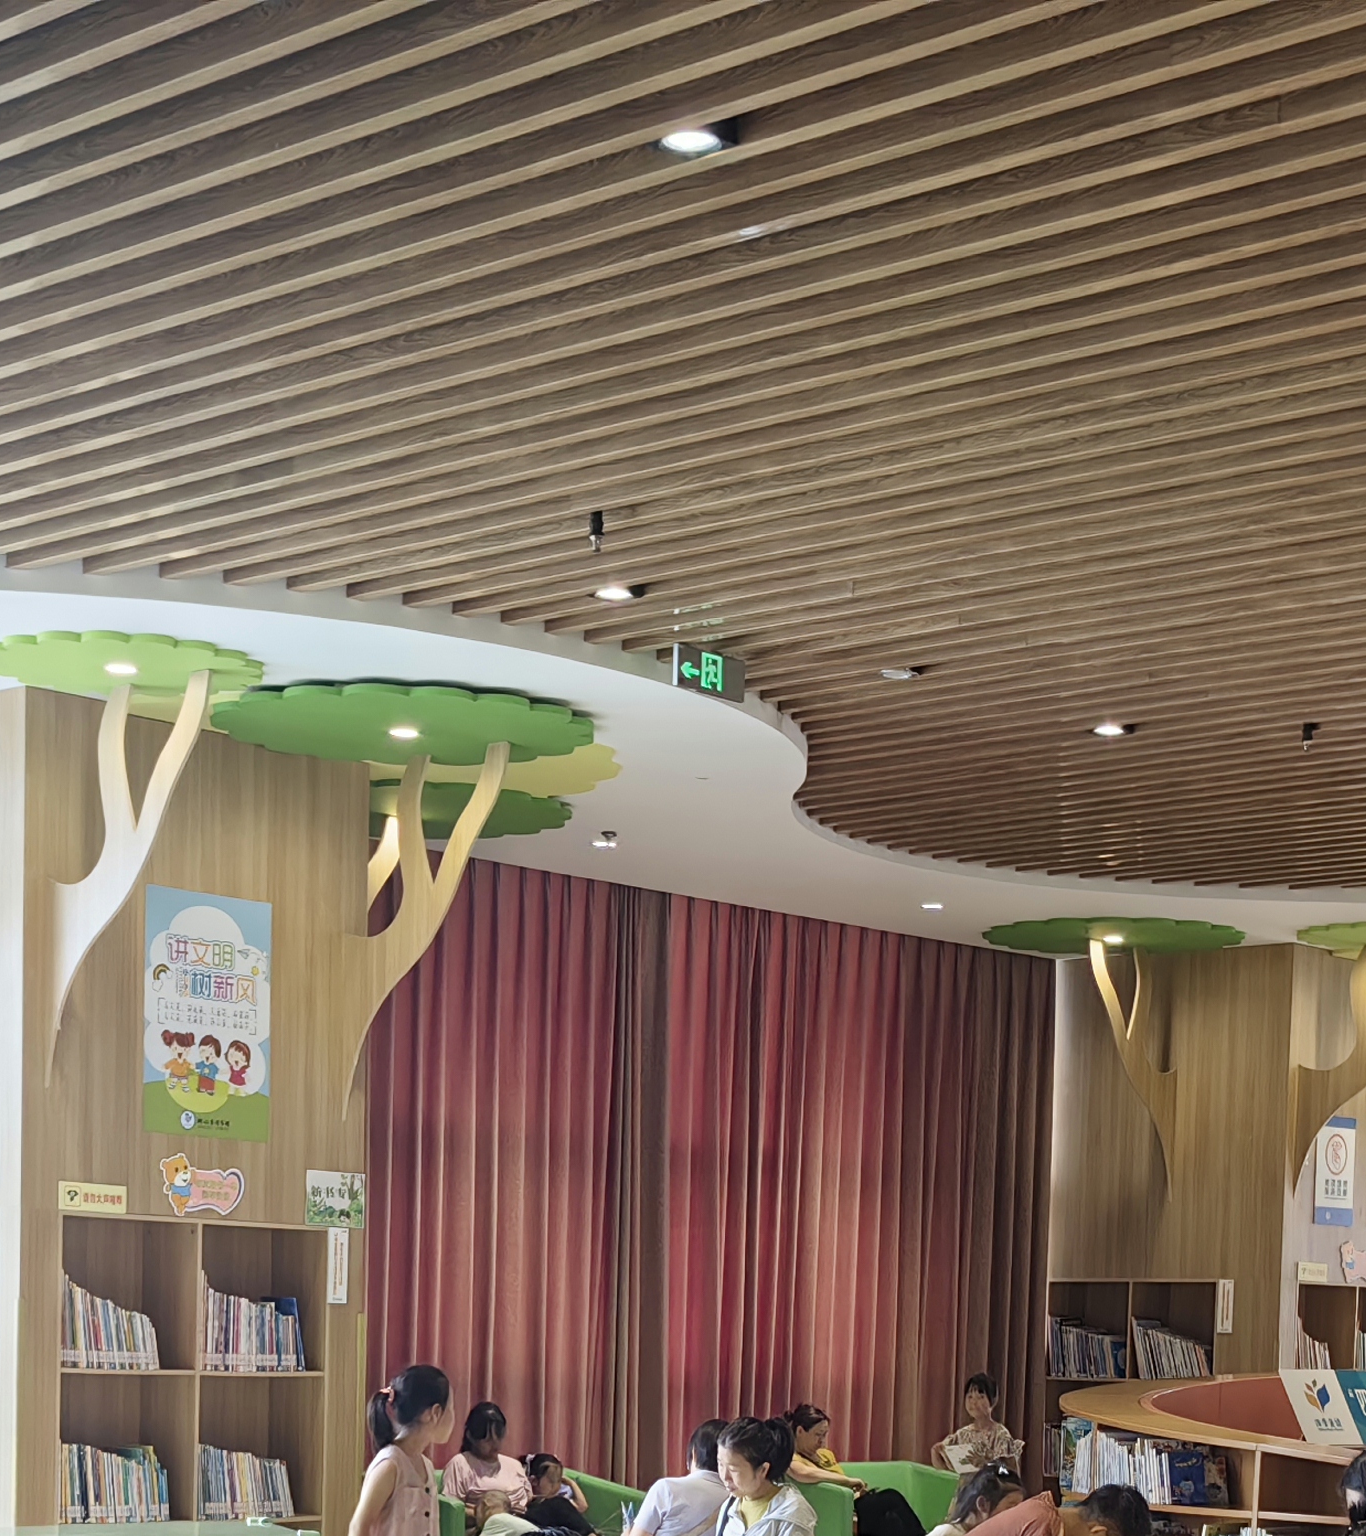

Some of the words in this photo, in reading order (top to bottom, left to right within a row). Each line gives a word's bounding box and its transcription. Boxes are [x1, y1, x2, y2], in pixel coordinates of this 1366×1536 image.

[167, 935, 235, 969] 讲文明
[191, 970, 256, 1005] 树新风
